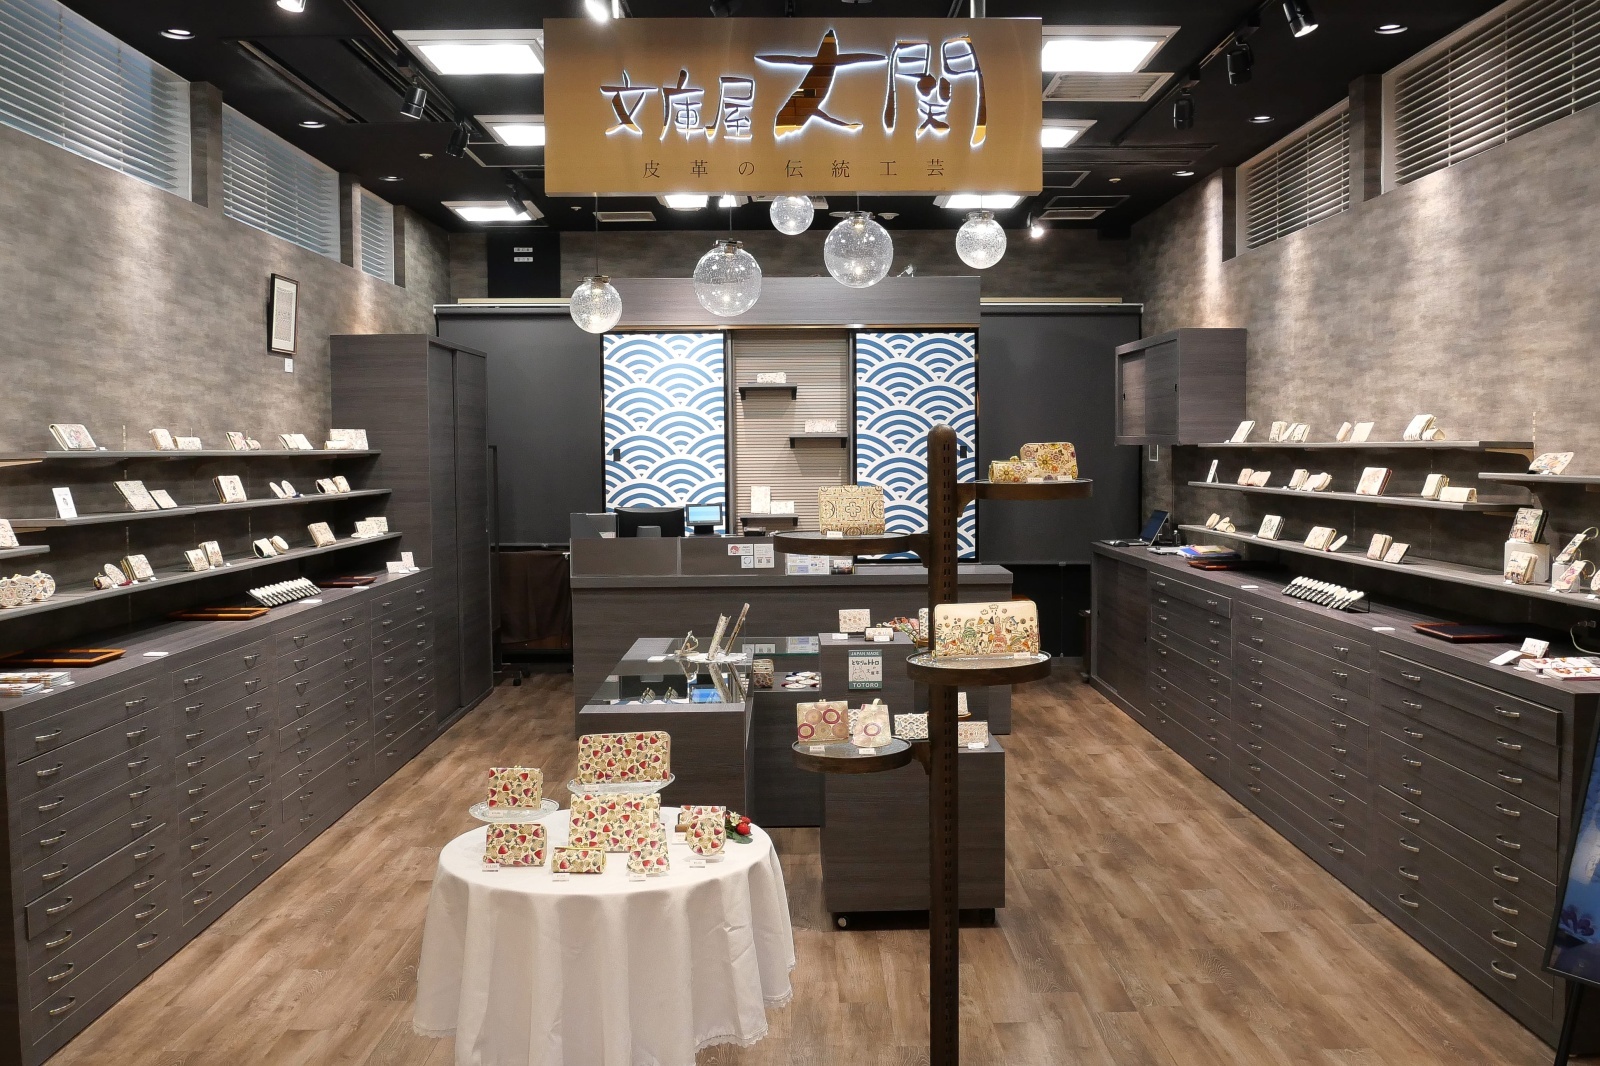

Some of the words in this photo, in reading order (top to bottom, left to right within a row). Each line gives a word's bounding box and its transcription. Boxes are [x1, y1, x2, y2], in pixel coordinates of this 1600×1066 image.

[642, 159, 945, 178] 皮革の伝統工芸
